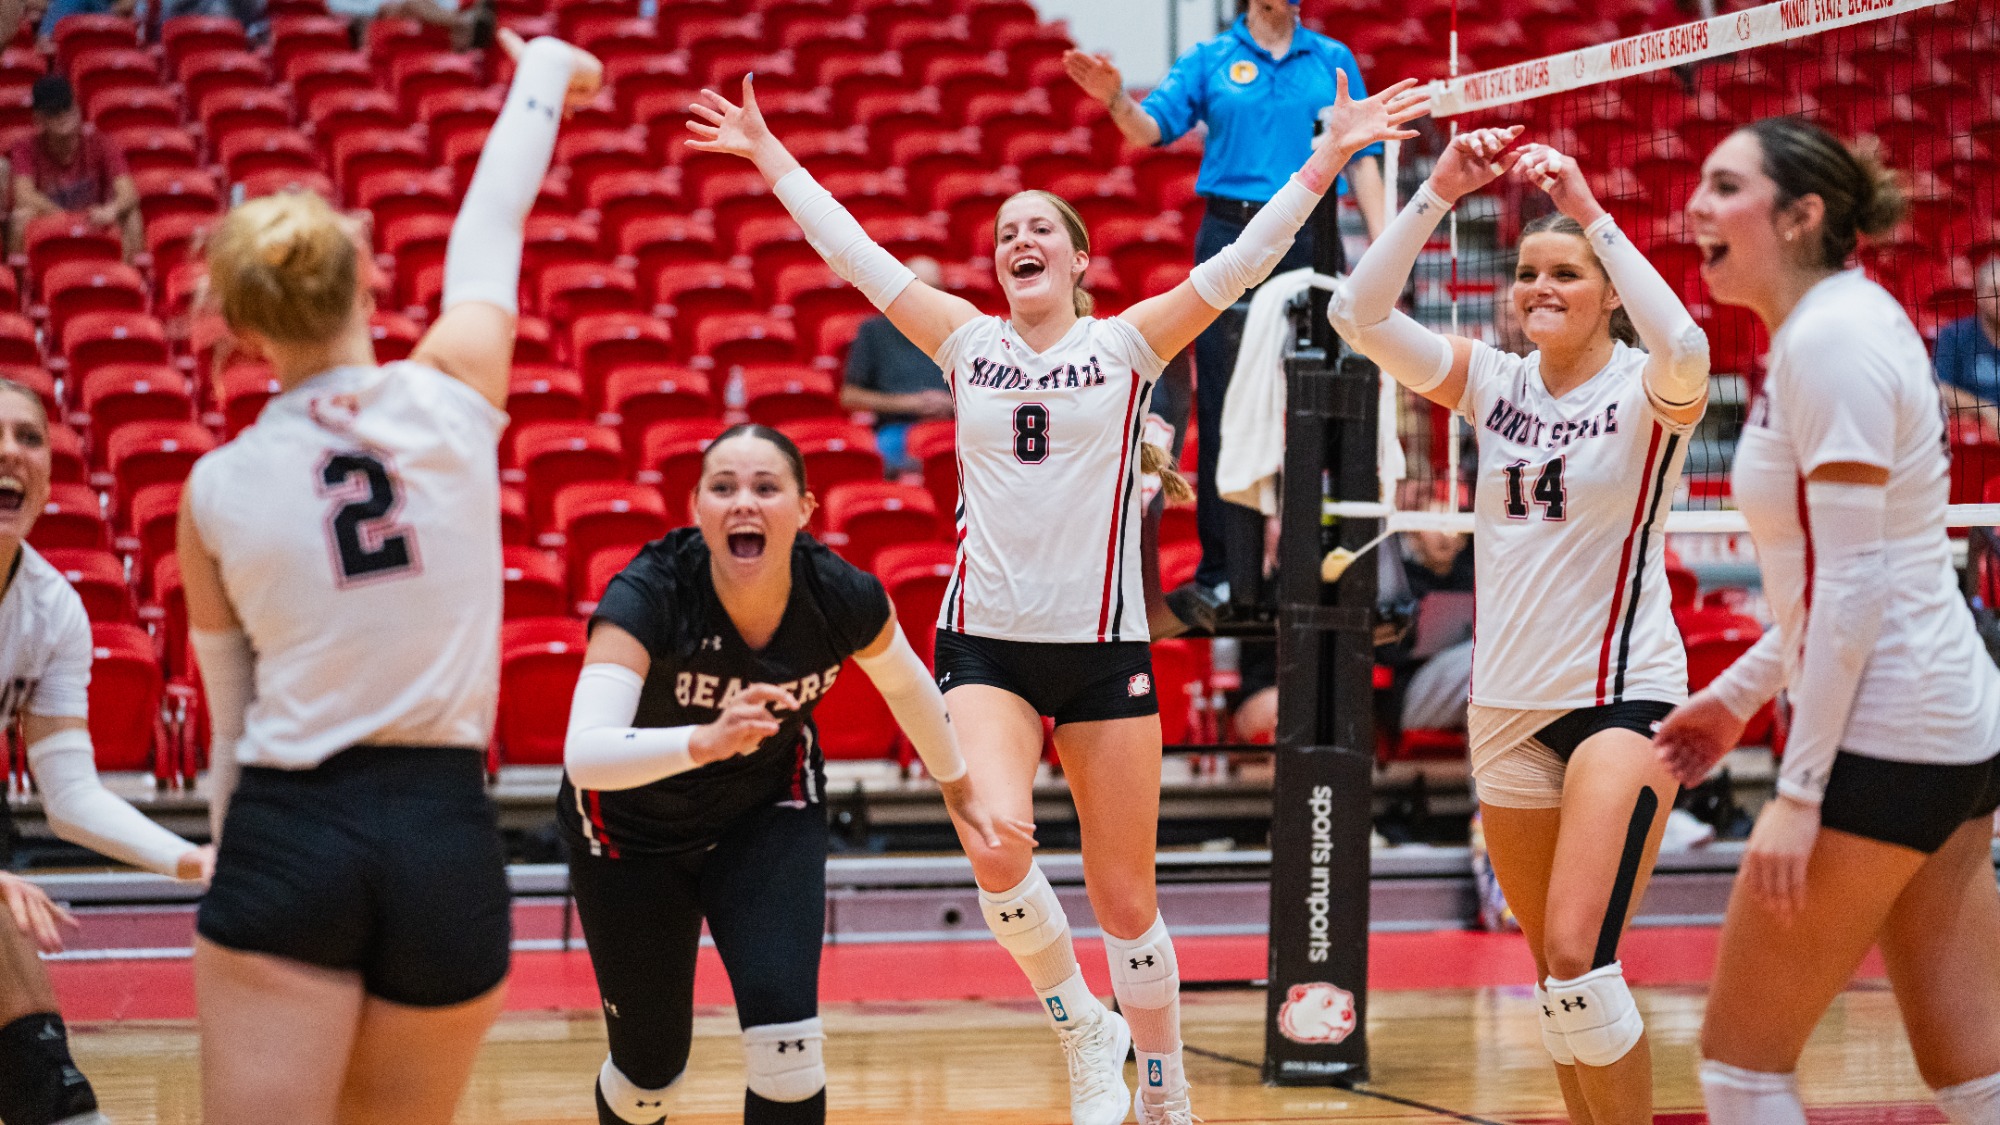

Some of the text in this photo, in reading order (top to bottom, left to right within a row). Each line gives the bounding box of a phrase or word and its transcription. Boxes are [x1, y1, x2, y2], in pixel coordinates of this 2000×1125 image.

[1781, 0, 1811, 31] MINOT
[1610, 21, 1708, 71] MINOT STATE BEAVERS
[1515, 61, 1550, 92] BEAVERS
[1012, 402, 1050, 465] 8
[1502, 454, 1567, 522] 14
[311, 448, 425, 592] 2
[674, 664, 841, 710] BEARS
[1304, 785, 1334, 963] sports imports
